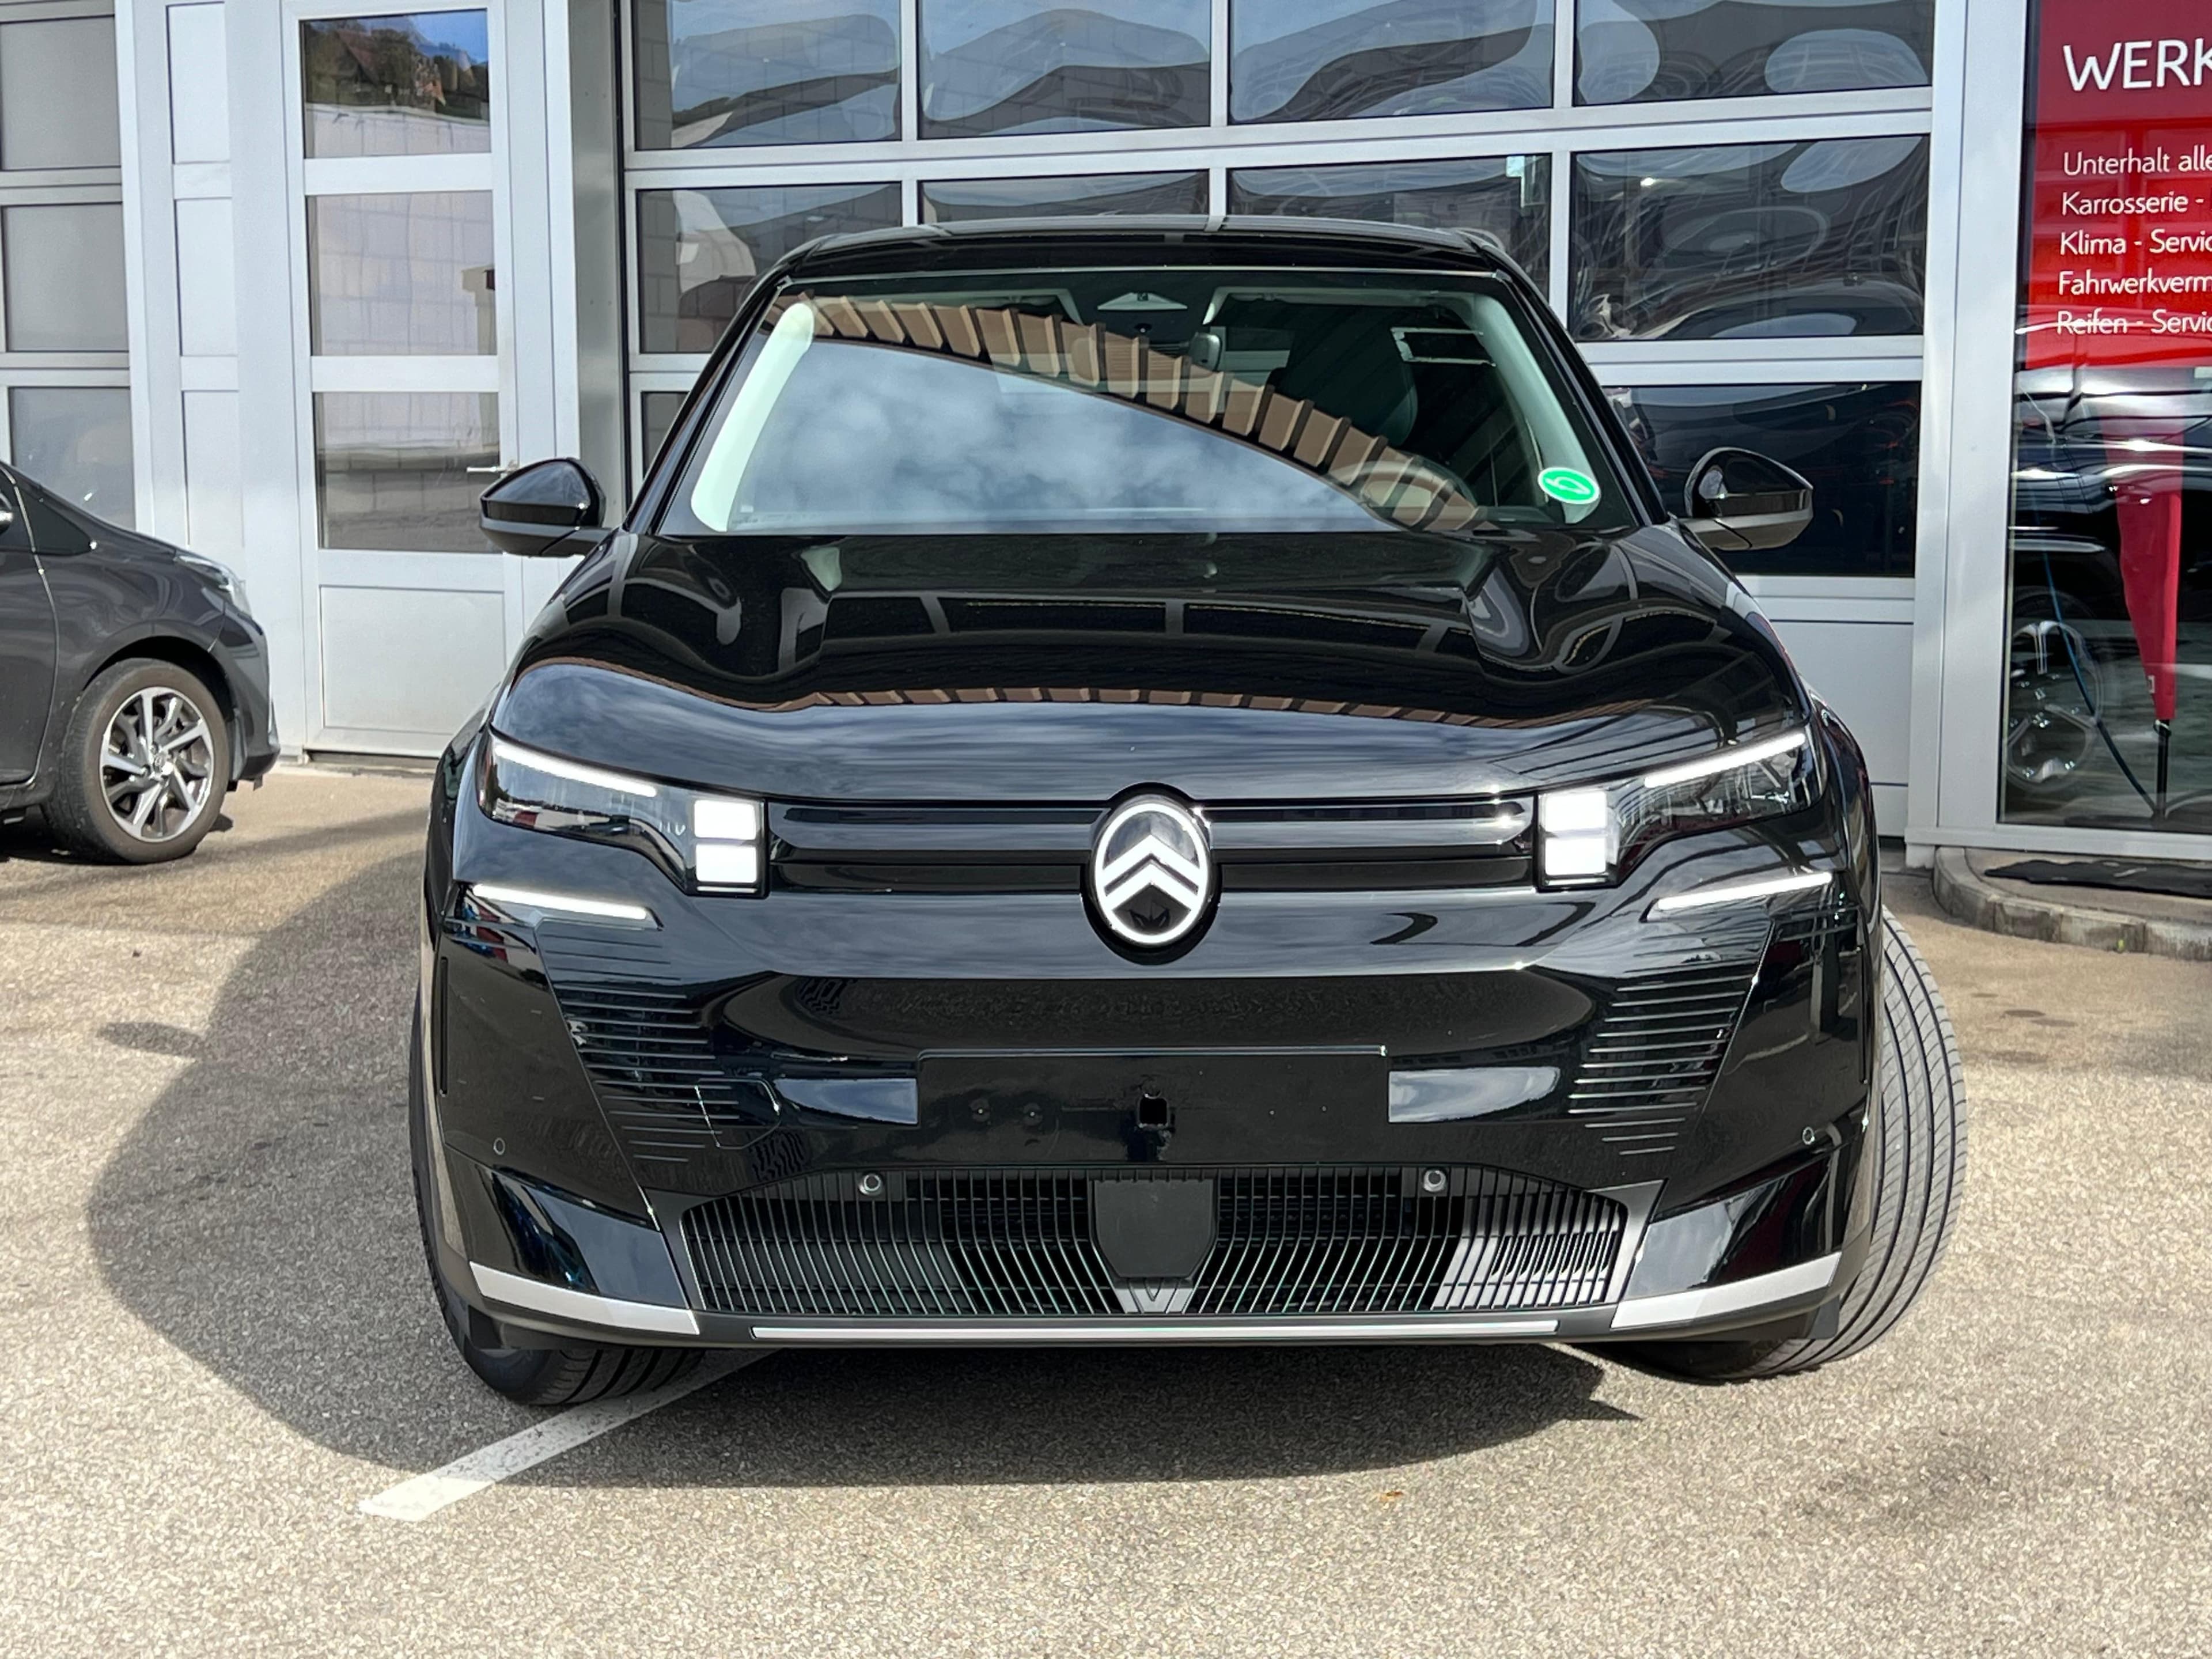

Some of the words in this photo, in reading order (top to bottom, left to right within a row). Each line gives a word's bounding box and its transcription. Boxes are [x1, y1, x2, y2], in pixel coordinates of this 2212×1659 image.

[2064, 147, 2170, 176] Unterhalt
[2062, 191, 2188, 215] Karrosserie
[2060, 229, 2126, 255] Klima
[2059, 267, 2212, 295] Fahrwerkverm
[2057, 308, 2128, 335] Reifen
